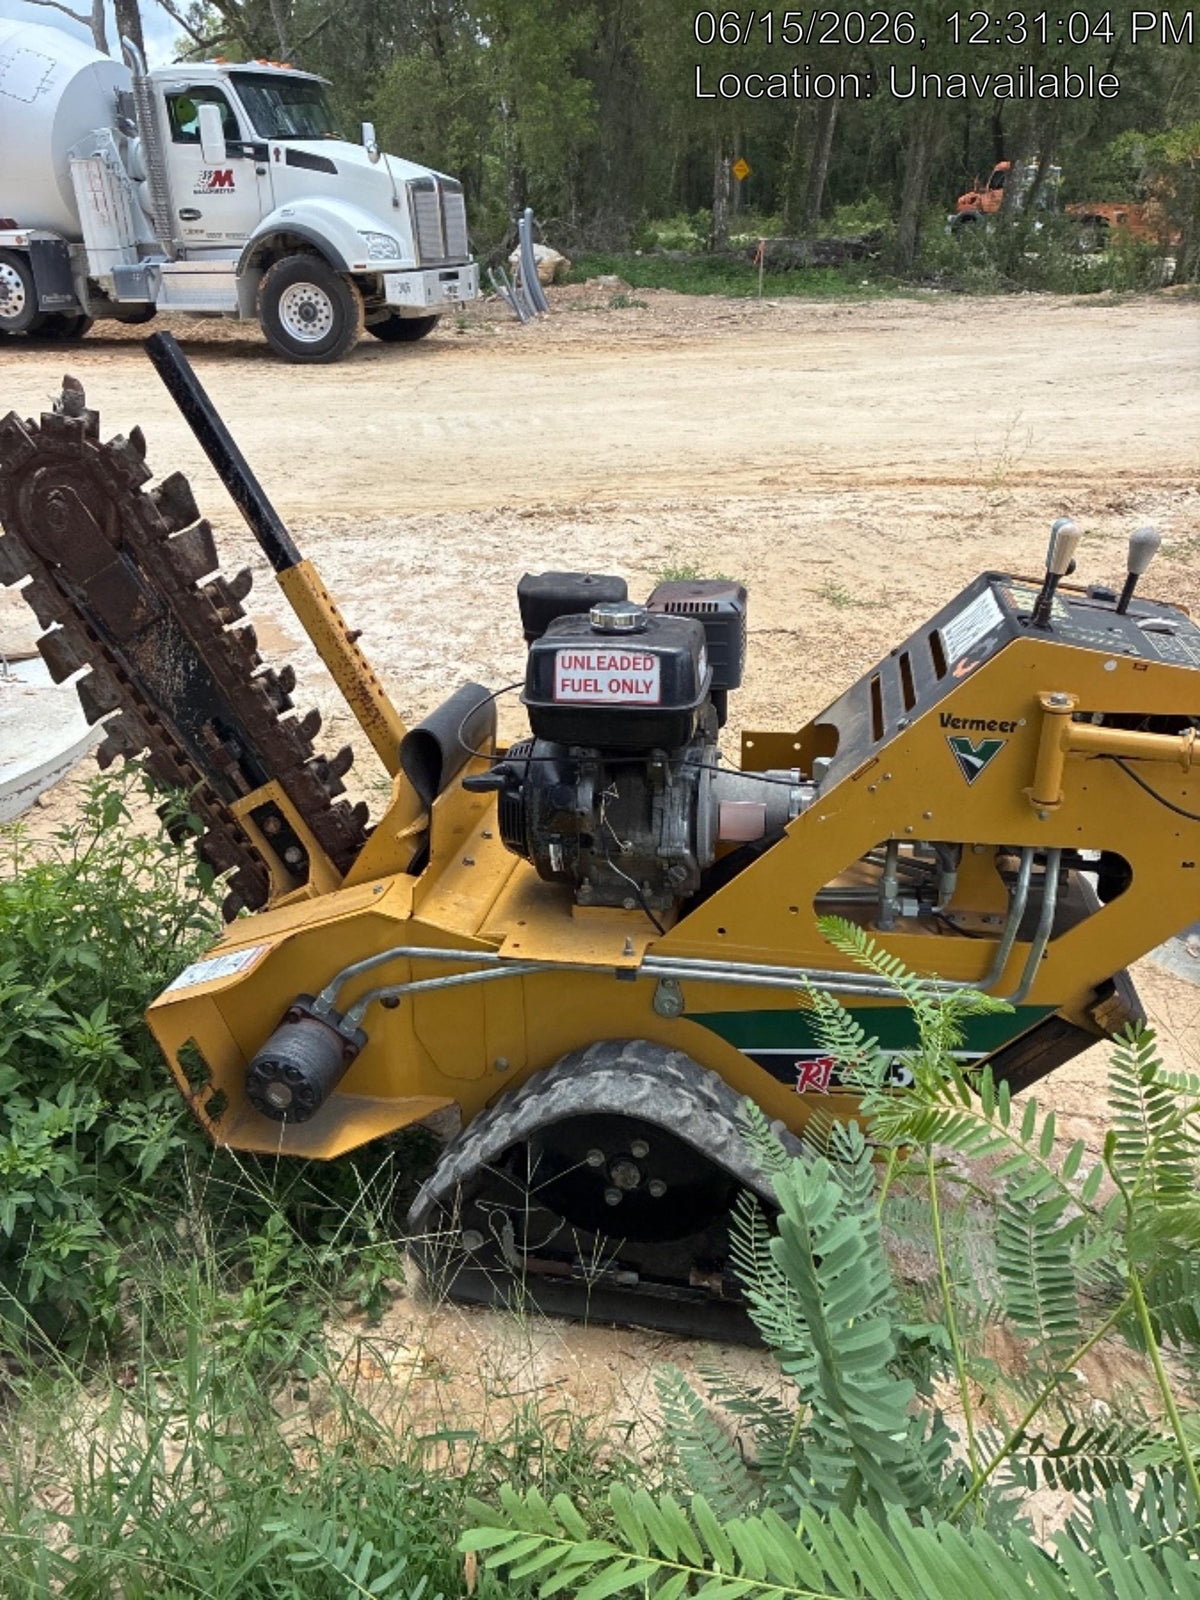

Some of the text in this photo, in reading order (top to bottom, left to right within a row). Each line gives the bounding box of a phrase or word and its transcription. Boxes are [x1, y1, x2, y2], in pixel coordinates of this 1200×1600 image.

[561, 654, 655, 671] UNLEADED
[561, 678, 654, 695] FUEL ONLY
[939, 712, 1018, 733] Vermeer
